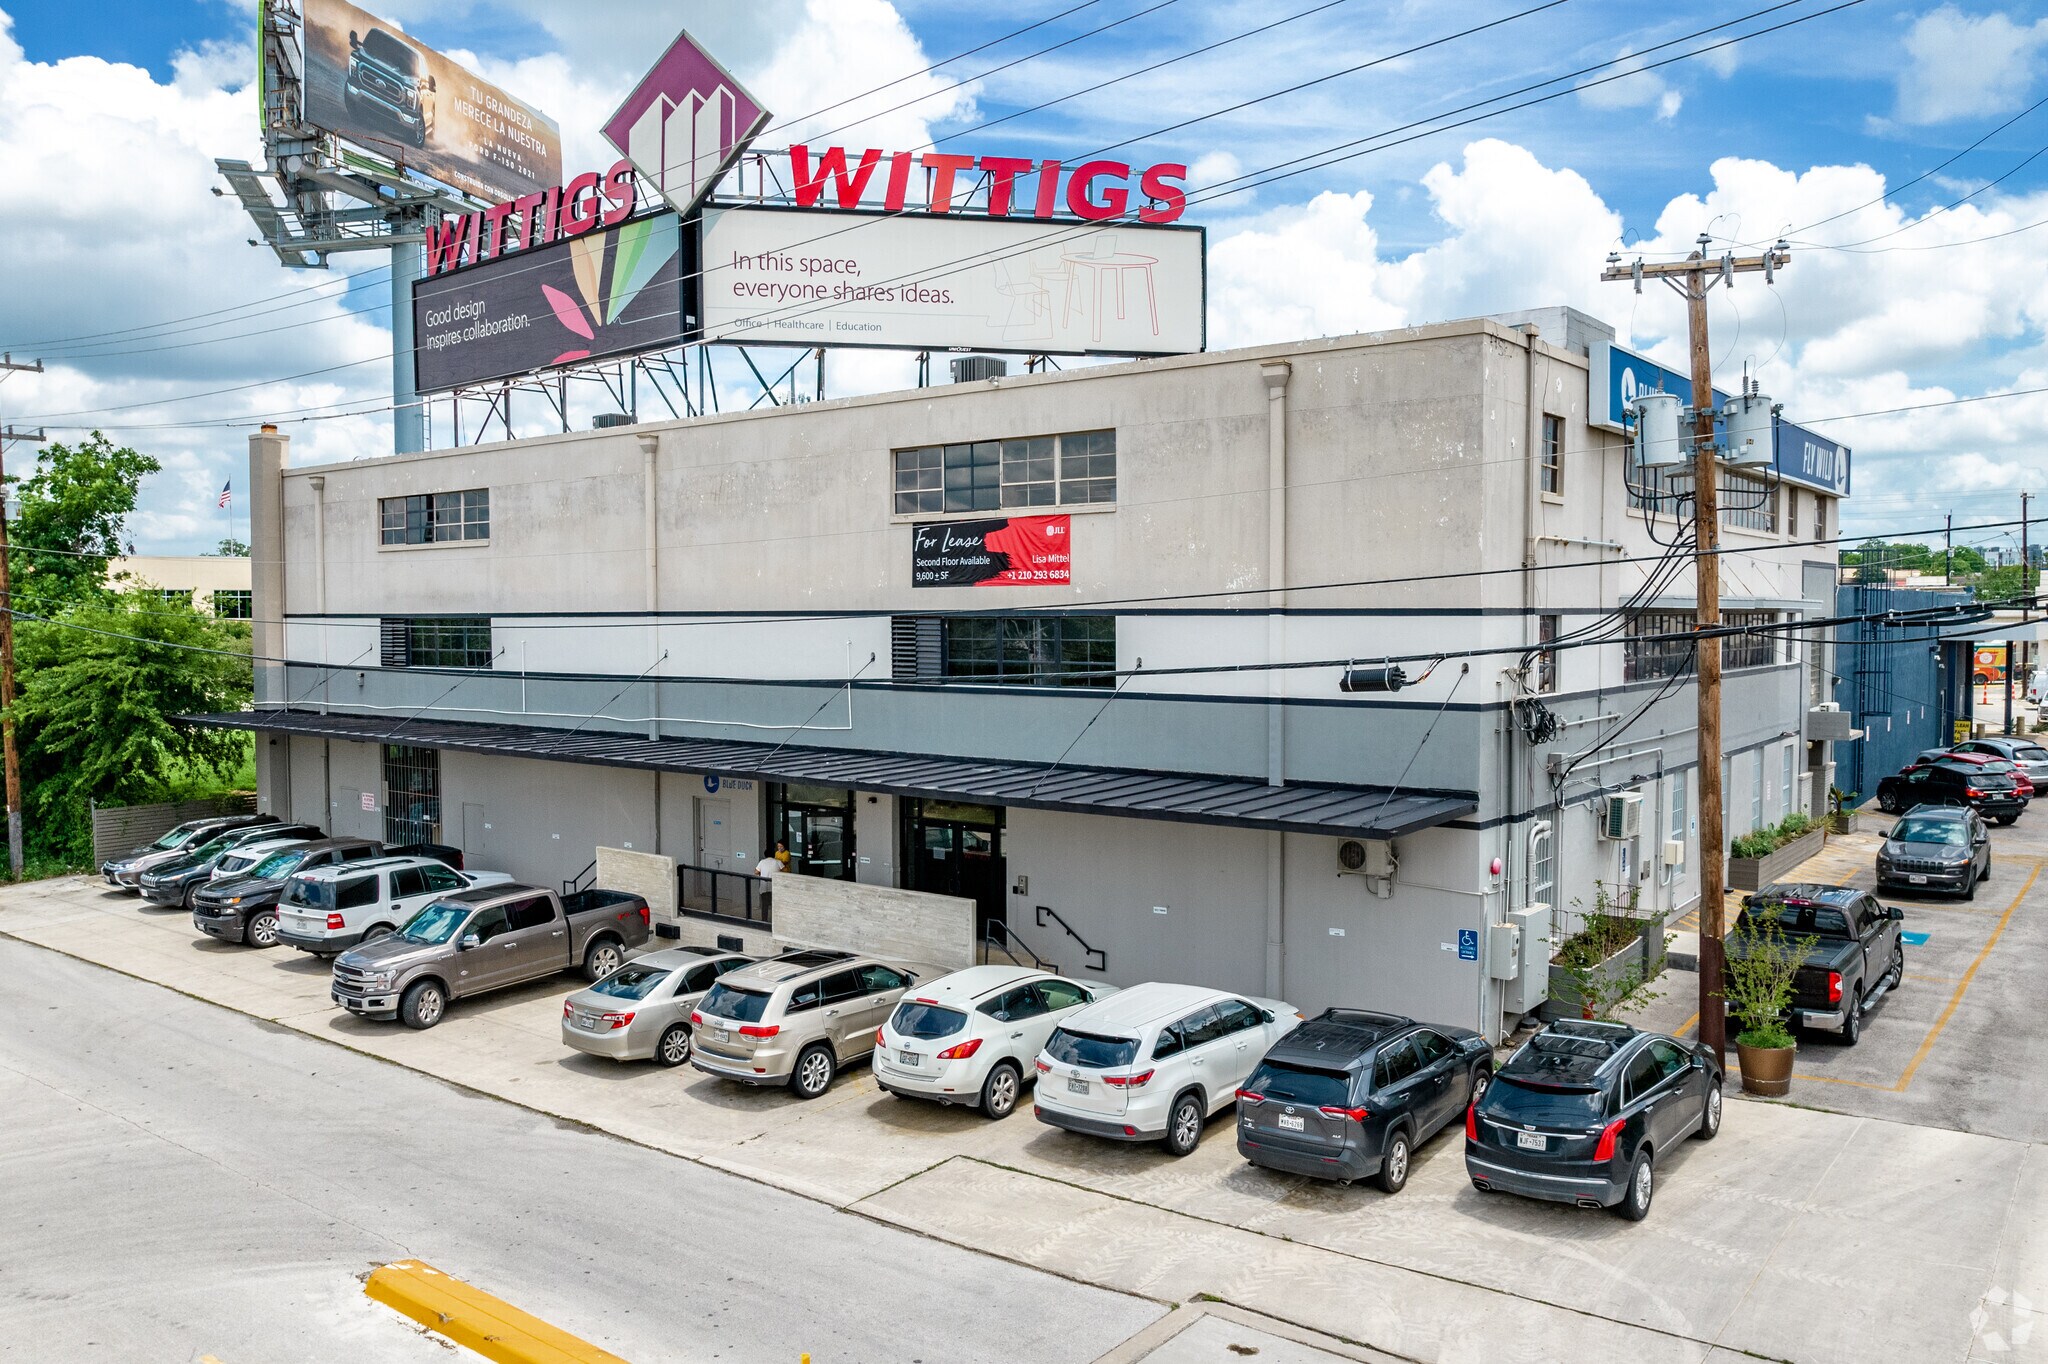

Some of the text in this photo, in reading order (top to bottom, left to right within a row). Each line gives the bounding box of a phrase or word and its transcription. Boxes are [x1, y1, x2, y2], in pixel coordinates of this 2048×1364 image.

[470, 86, 533, 132] TU GRANDEZA
[454, 96, 547, 158] MERECE LA NUESTRA
[469, 141, 535, 180] FORD F-150 2021
[483, 137, 522, 162] LA NUEVA
[789, 143, 1187, 223] WITTIGS
[426, 158, 636, 277] WITTIGS
[733, 250, 861, 277] In this space,
[733, 280, 954, 304] everyone shares ideas.
[425, 300, 486, 327] Good design
[734, 318, 882, 332] Office Healthcare Education
[426, 313, 531, 351] inspires collaboration.
[1802, 441, 1834, 482] FLY WILD
[914, 527, 984, 553] For Lease
[916, 556, 991, 567] Second Floor Available
[1032, 553, 1070, 564] Lisa Mittel
[916, 571, 934, 582] 9,600
[940, 571, 950, 580] SF
[1007, 569, 1070, 580] +1 210 293 6834
